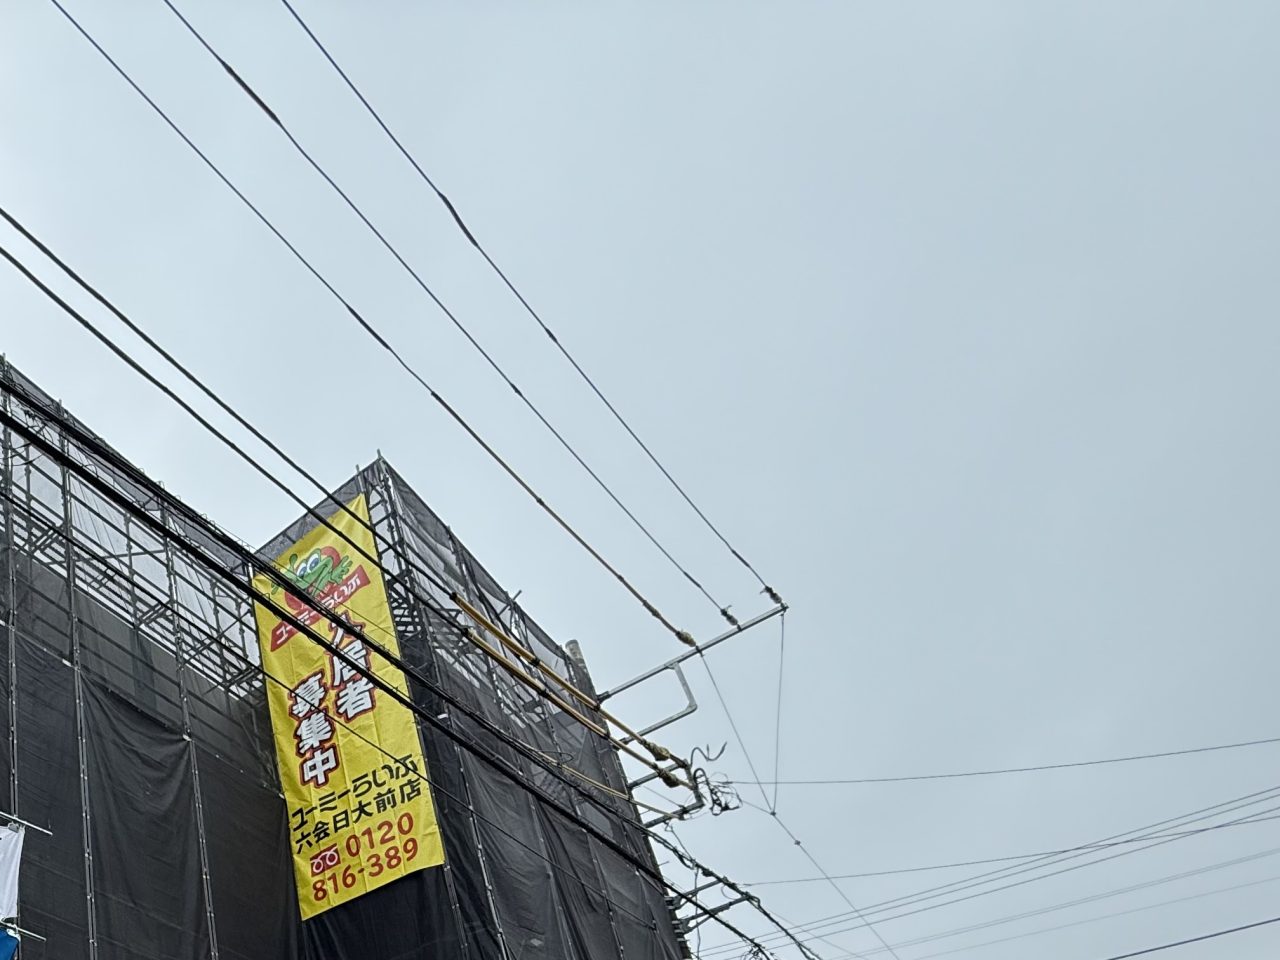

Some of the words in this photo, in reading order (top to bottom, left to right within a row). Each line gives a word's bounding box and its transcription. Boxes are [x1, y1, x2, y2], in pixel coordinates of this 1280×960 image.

[292, 673, 337, 786] 募集中
[291, 753, 419, 832] ユーミーらいふ
[295, 777, 422, 854] 六会日大前店
[311, 837, 419, 902] 816-389
[345, 811, 414, 858] 0120
